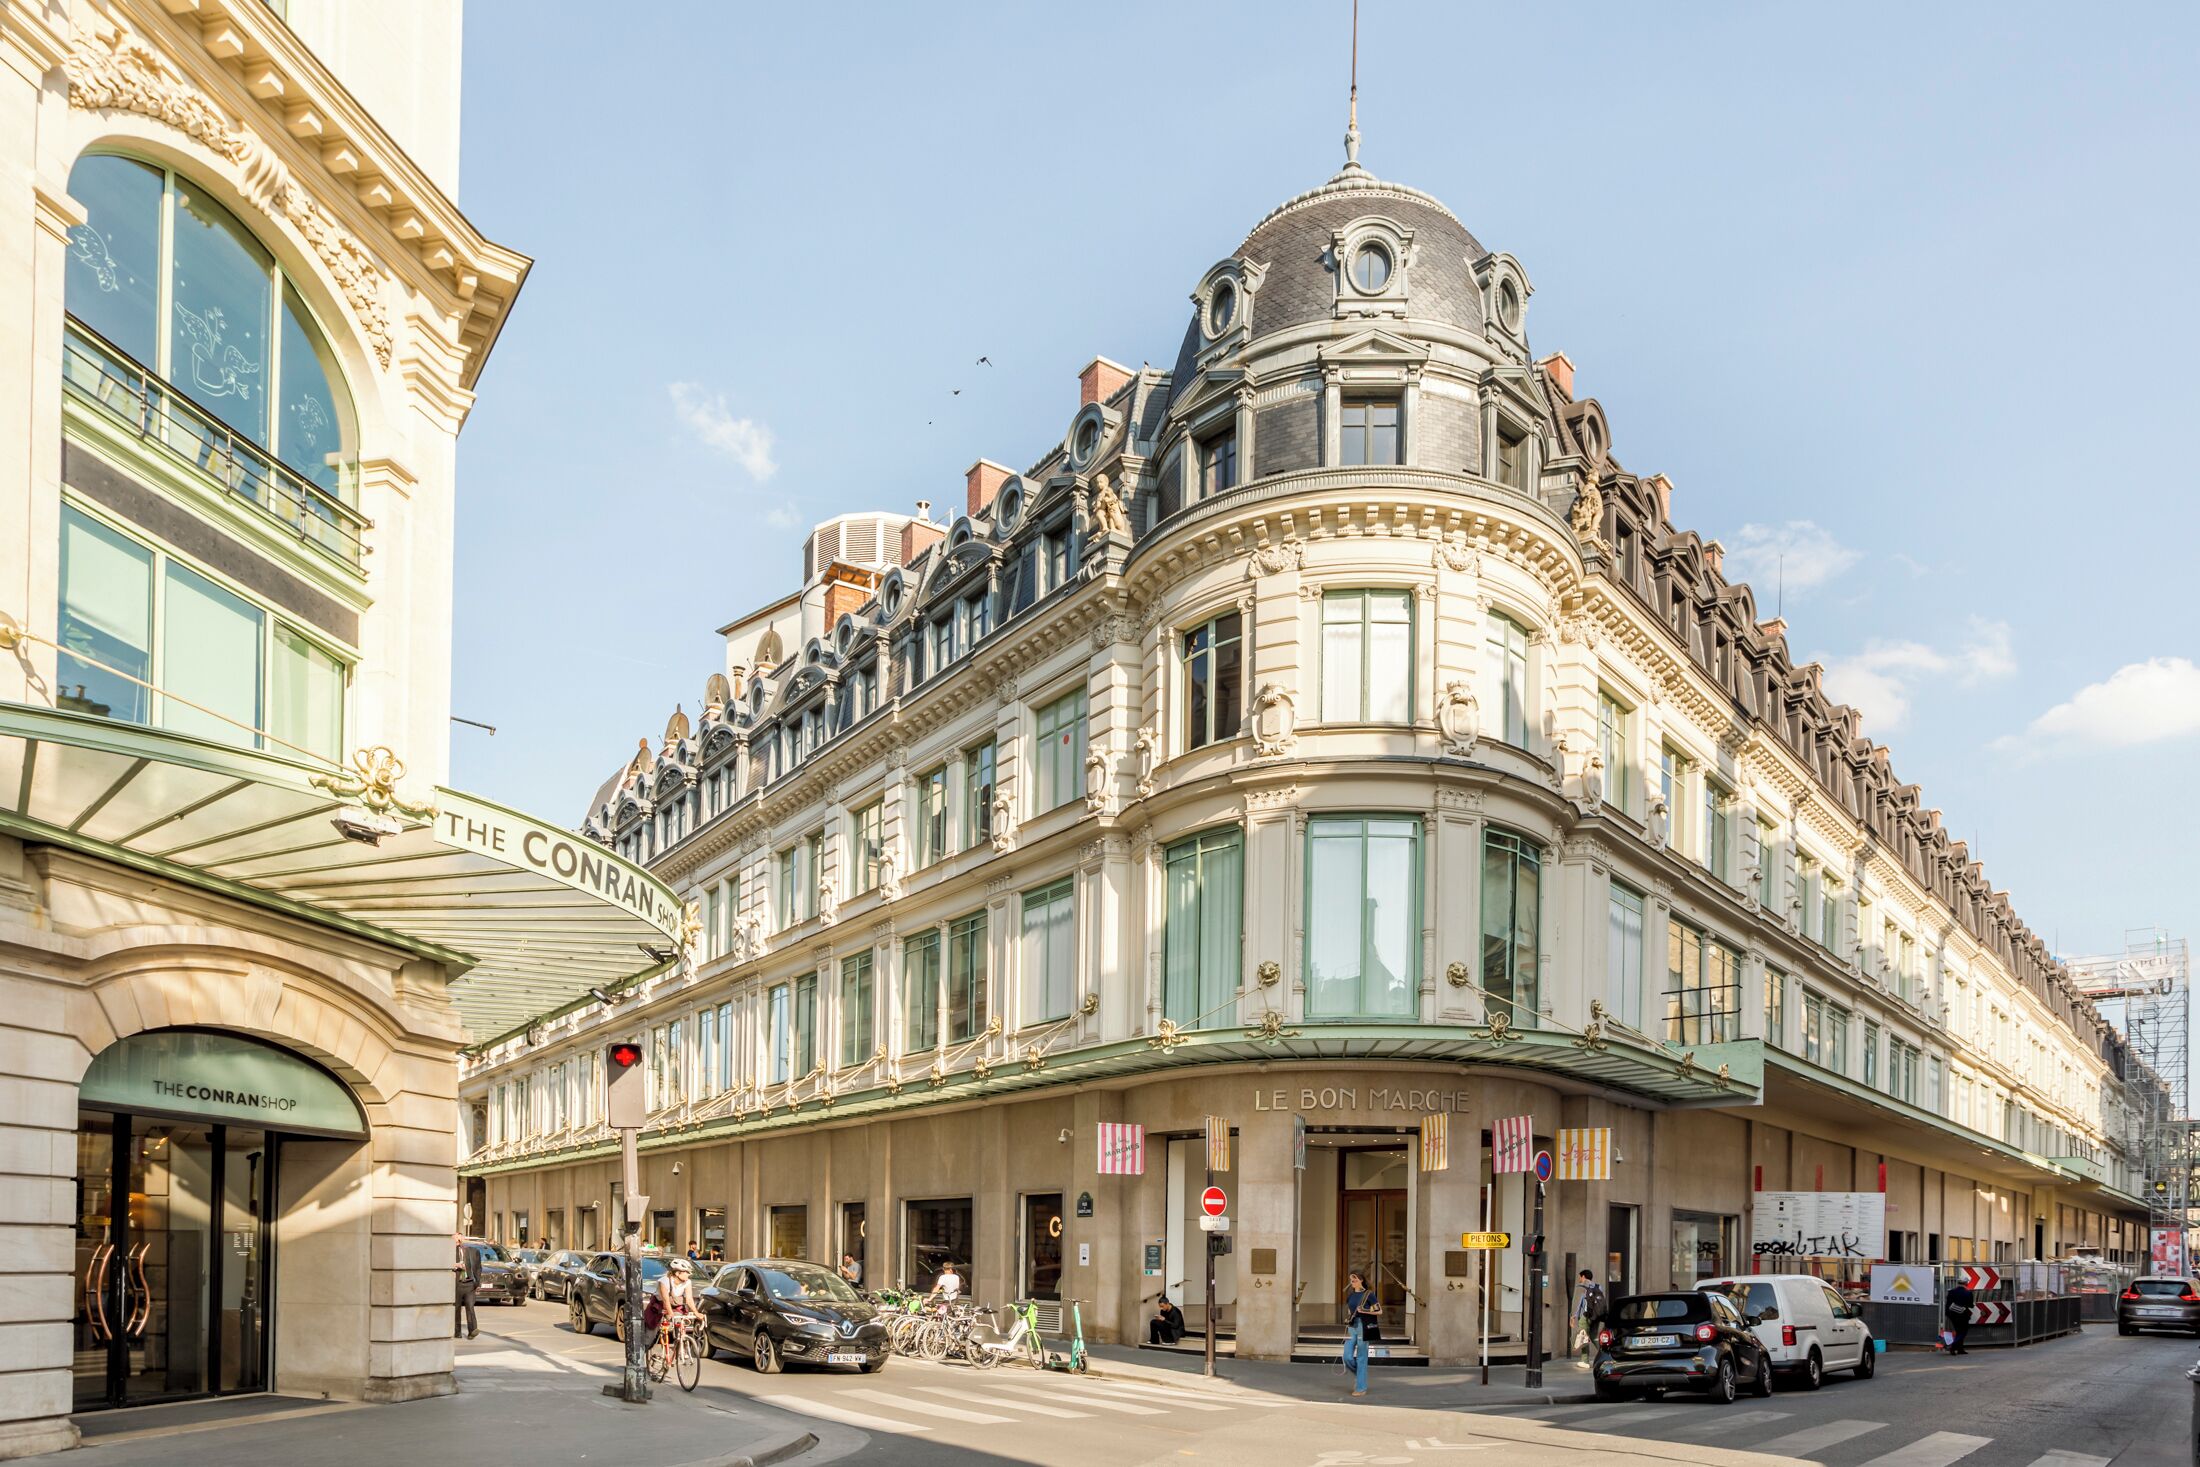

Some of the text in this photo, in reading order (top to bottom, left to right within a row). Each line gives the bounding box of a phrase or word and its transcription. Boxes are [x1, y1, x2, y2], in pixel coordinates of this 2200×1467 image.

[444, 811, 505, 852] THE
[523, 831, 654, 917] CONRAN
[1255, 1090, 1289, 1111] LE
[1300, 1087, 1356, 1111] BON
[1470, 1234, 1502, 1243] PIETONS
